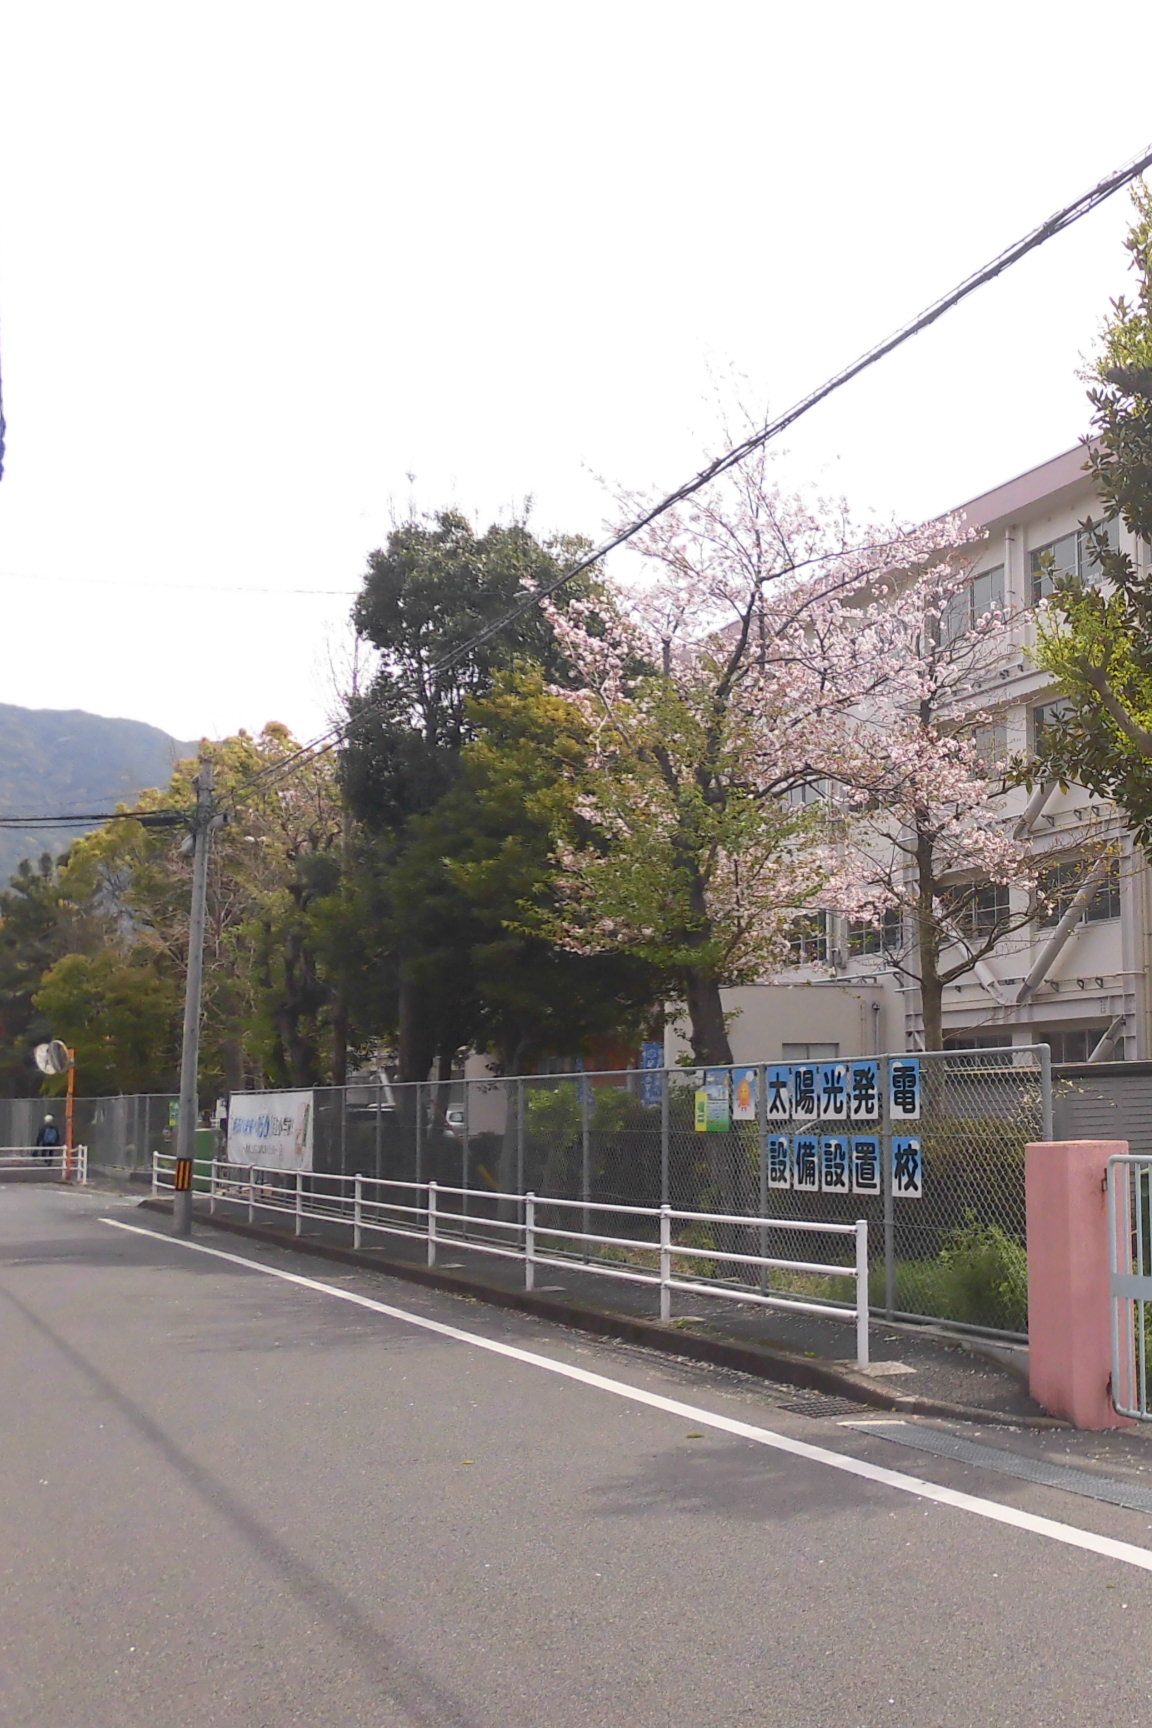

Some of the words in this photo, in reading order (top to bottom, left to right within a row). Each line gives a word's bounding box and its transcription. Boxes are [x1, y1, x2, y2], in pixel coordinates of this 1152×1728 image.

[769, 1066, 917, 1115] 太陽光発電
[770, 1141, 918, 1192] 設備設置校
